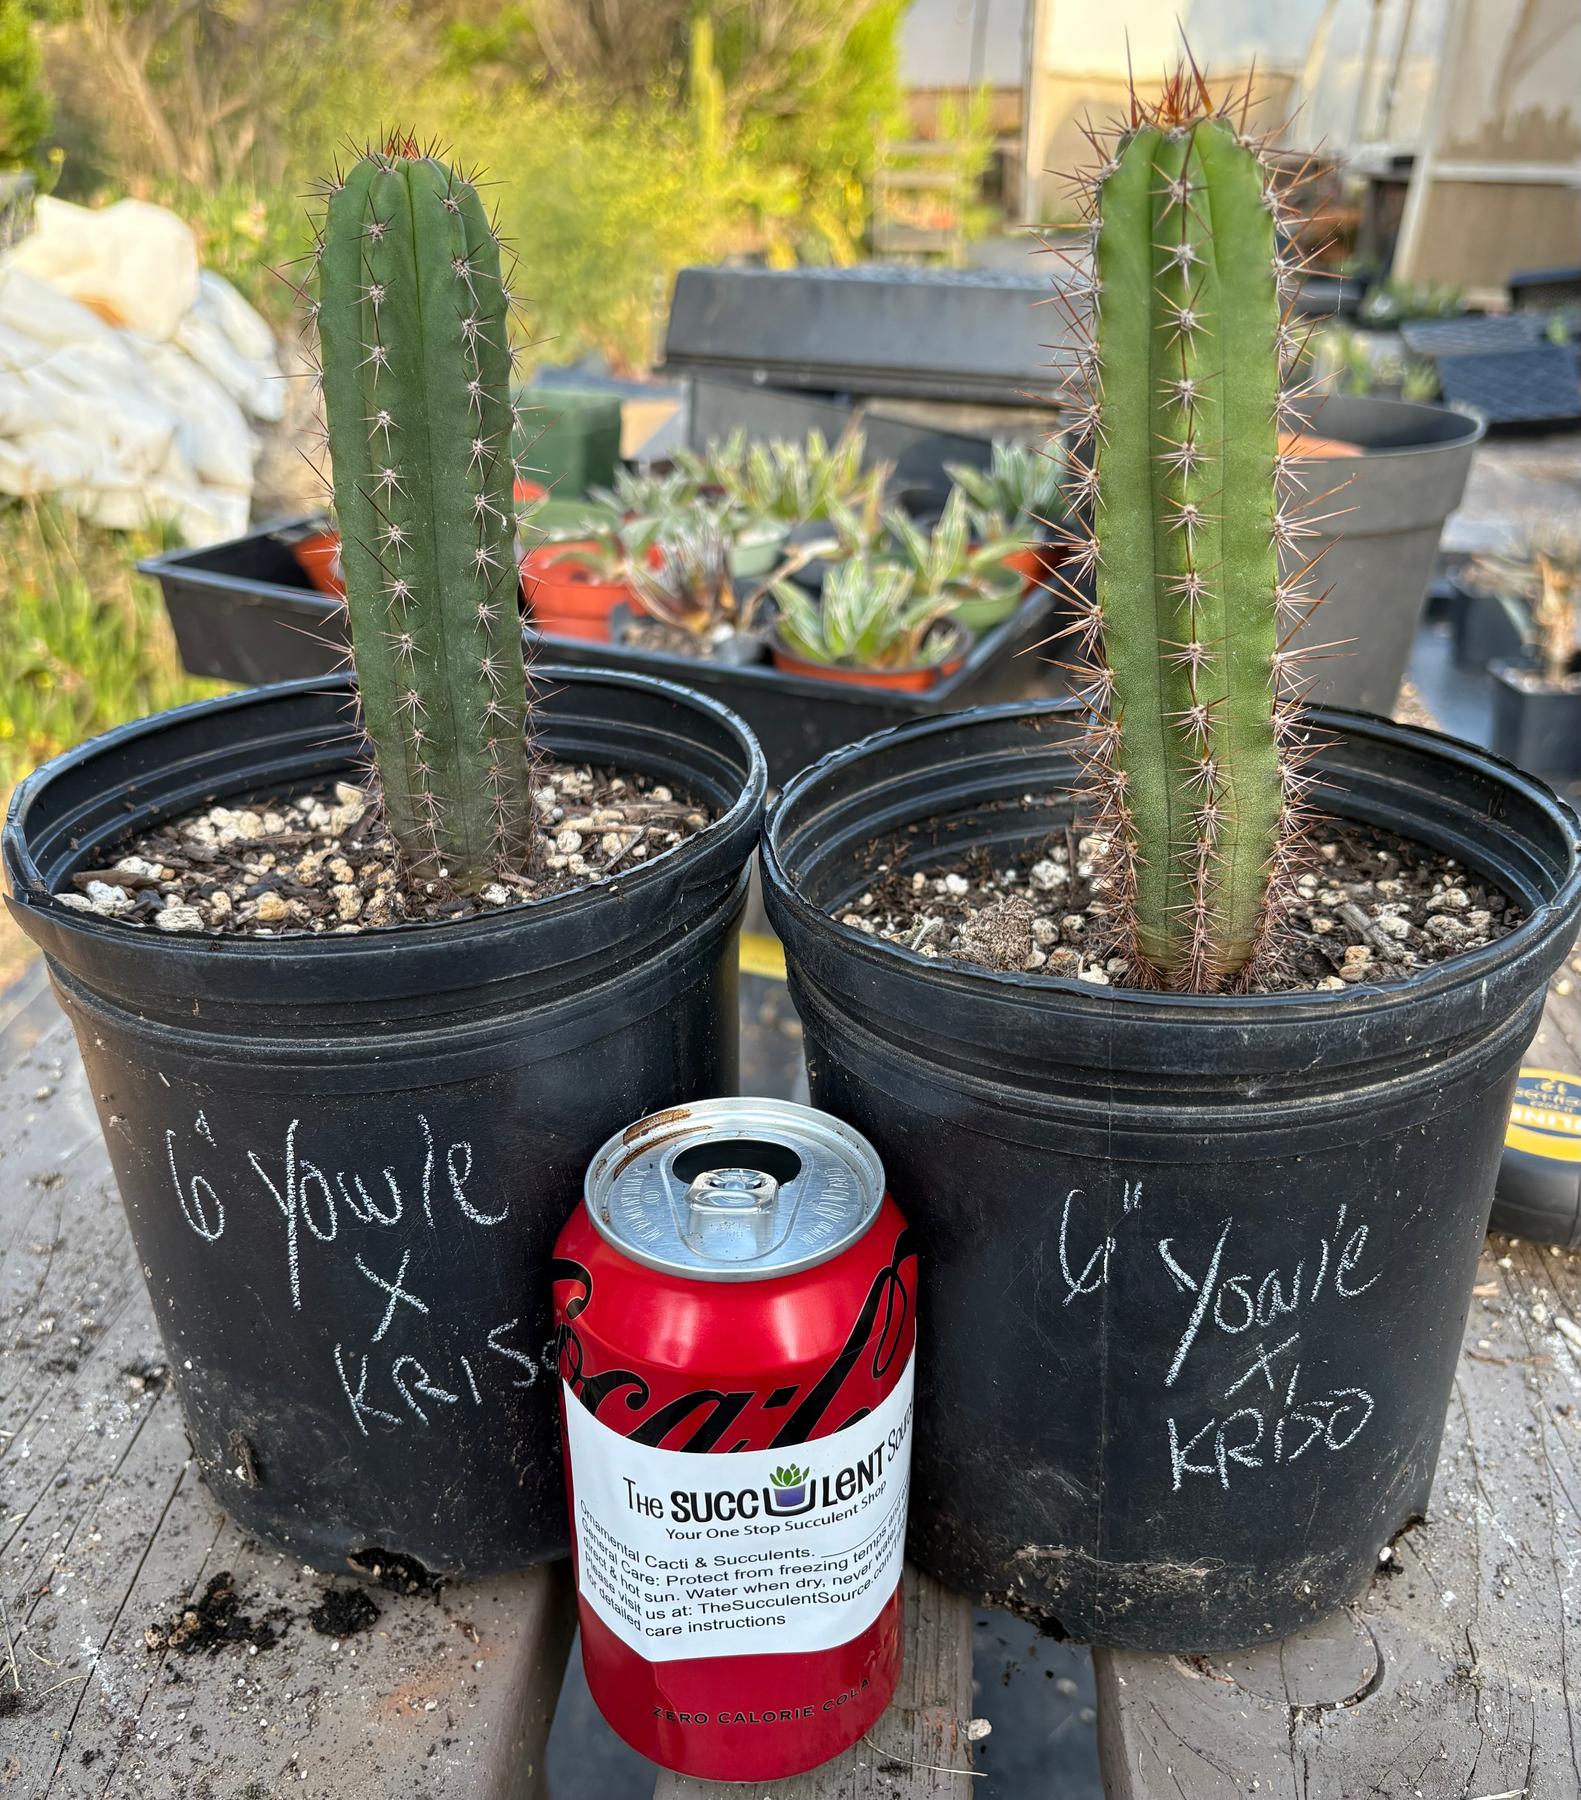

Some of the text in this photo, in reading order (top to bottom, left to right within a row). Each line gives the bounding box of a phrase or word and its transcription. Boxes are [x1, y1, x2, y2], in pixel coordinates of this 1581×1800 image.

[581, 1499, 815, 1570] Ornamental Cacti & Succulents.
[665, 1528, 702, 1540] Your
[706, 1527, 739, 1539] One
[744, 1525, 781, 1536] Stop
[784, 1503, 858, 1532] Succulent
[861, 1480, 887, 1510] Shop
[582, 1517, 618, 1565] General
[621, 1559, 660, 1587] Care:
[666, 1571, 729, 1587] Protect
[735, 1568, 773, 1580] from
[780, 1558, 848, 1576] freezing
[853, 1526, 887, 1563] temps
[583, 1535, 607, 1572] direct
[609, 1565, 618, 1581] &
[621, 1573, 641, 1599] hot
[644, 1592, 680, 1603] sun.
[685, 1586, 738, 1600] Water
[743, 1580, 790, 1594] when
[795, 1576, 826, 1590] dry,
[832, 1559, 873, 1586] never
[874, 1522, 897, 1561] water
[585, 1550, 615, 1594] Please
[618, 1587, 642, 1616] visit
[645, 1608, 666, 1620] us
[671, 1605, 692, 1618] at:
[586, 1568, 787, 1637] for detailed care instructions
[652, 1678, 870, 1724] ZERO CALORIE COLA
